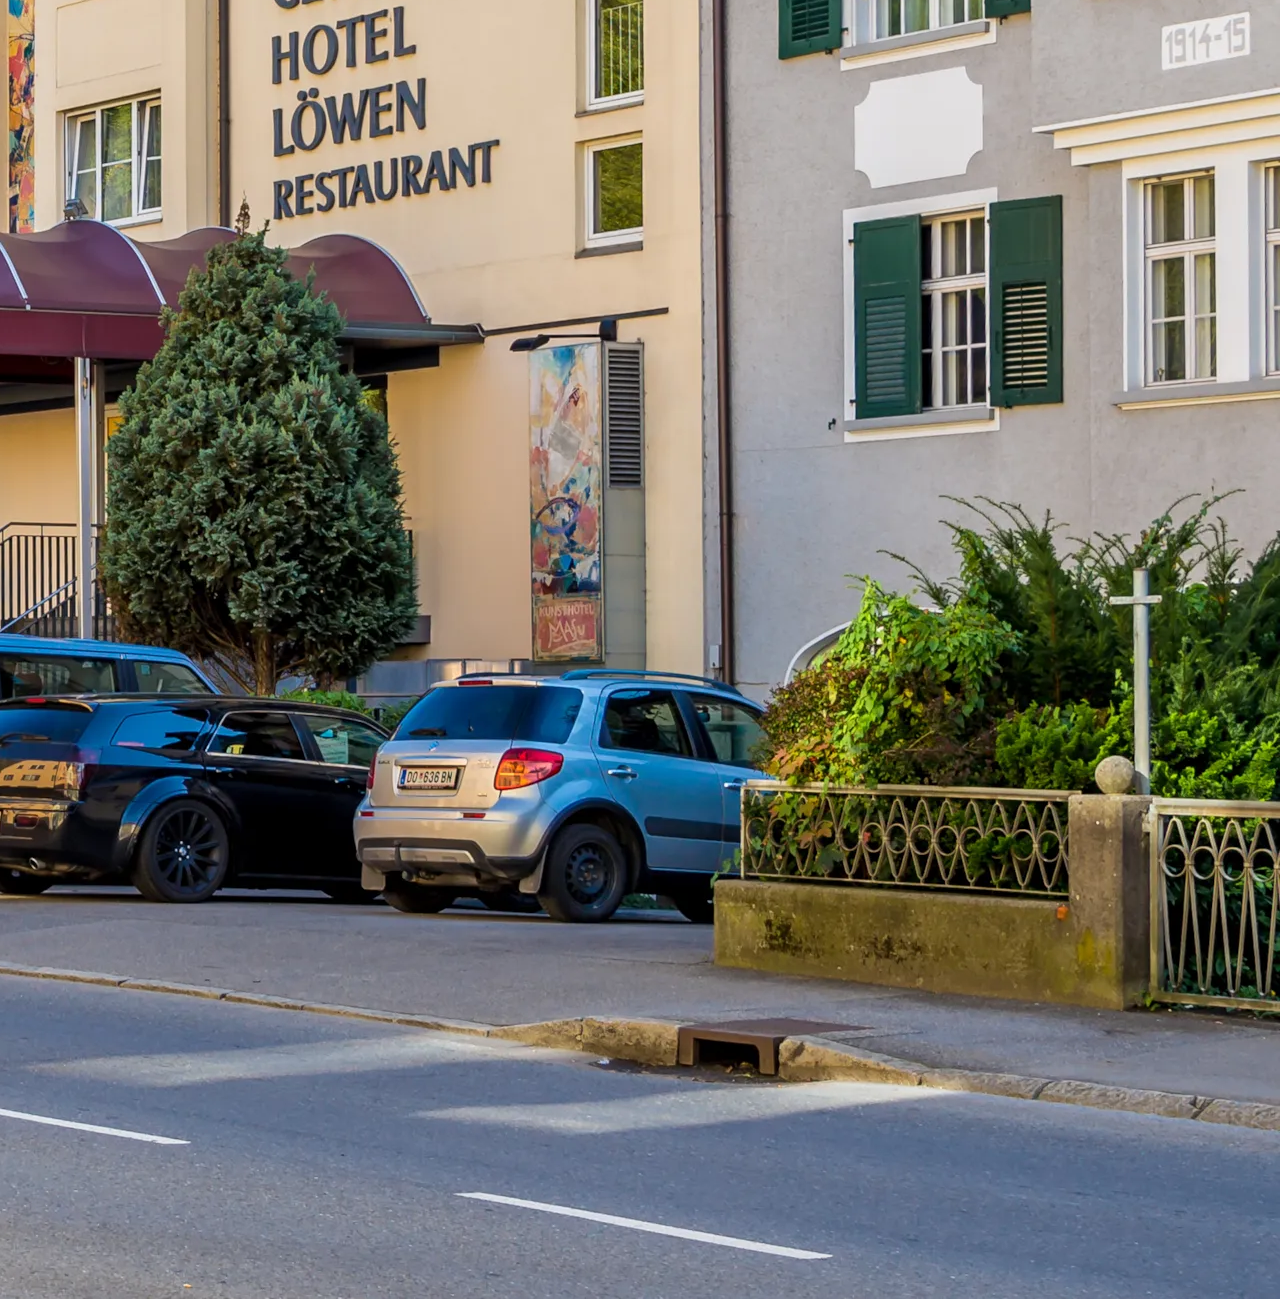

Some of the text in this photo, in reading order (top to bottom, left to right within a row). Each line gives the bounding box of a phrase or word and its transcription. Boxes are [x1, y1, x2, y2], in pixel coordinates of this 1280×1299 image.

[271, 6, 417, 85] HOTEL
[1164, 16, 1246, 64] 1914-15
[272, 77, 427, 158] LÖWEN
[272, 139, 500, 221] RESTAURANT
